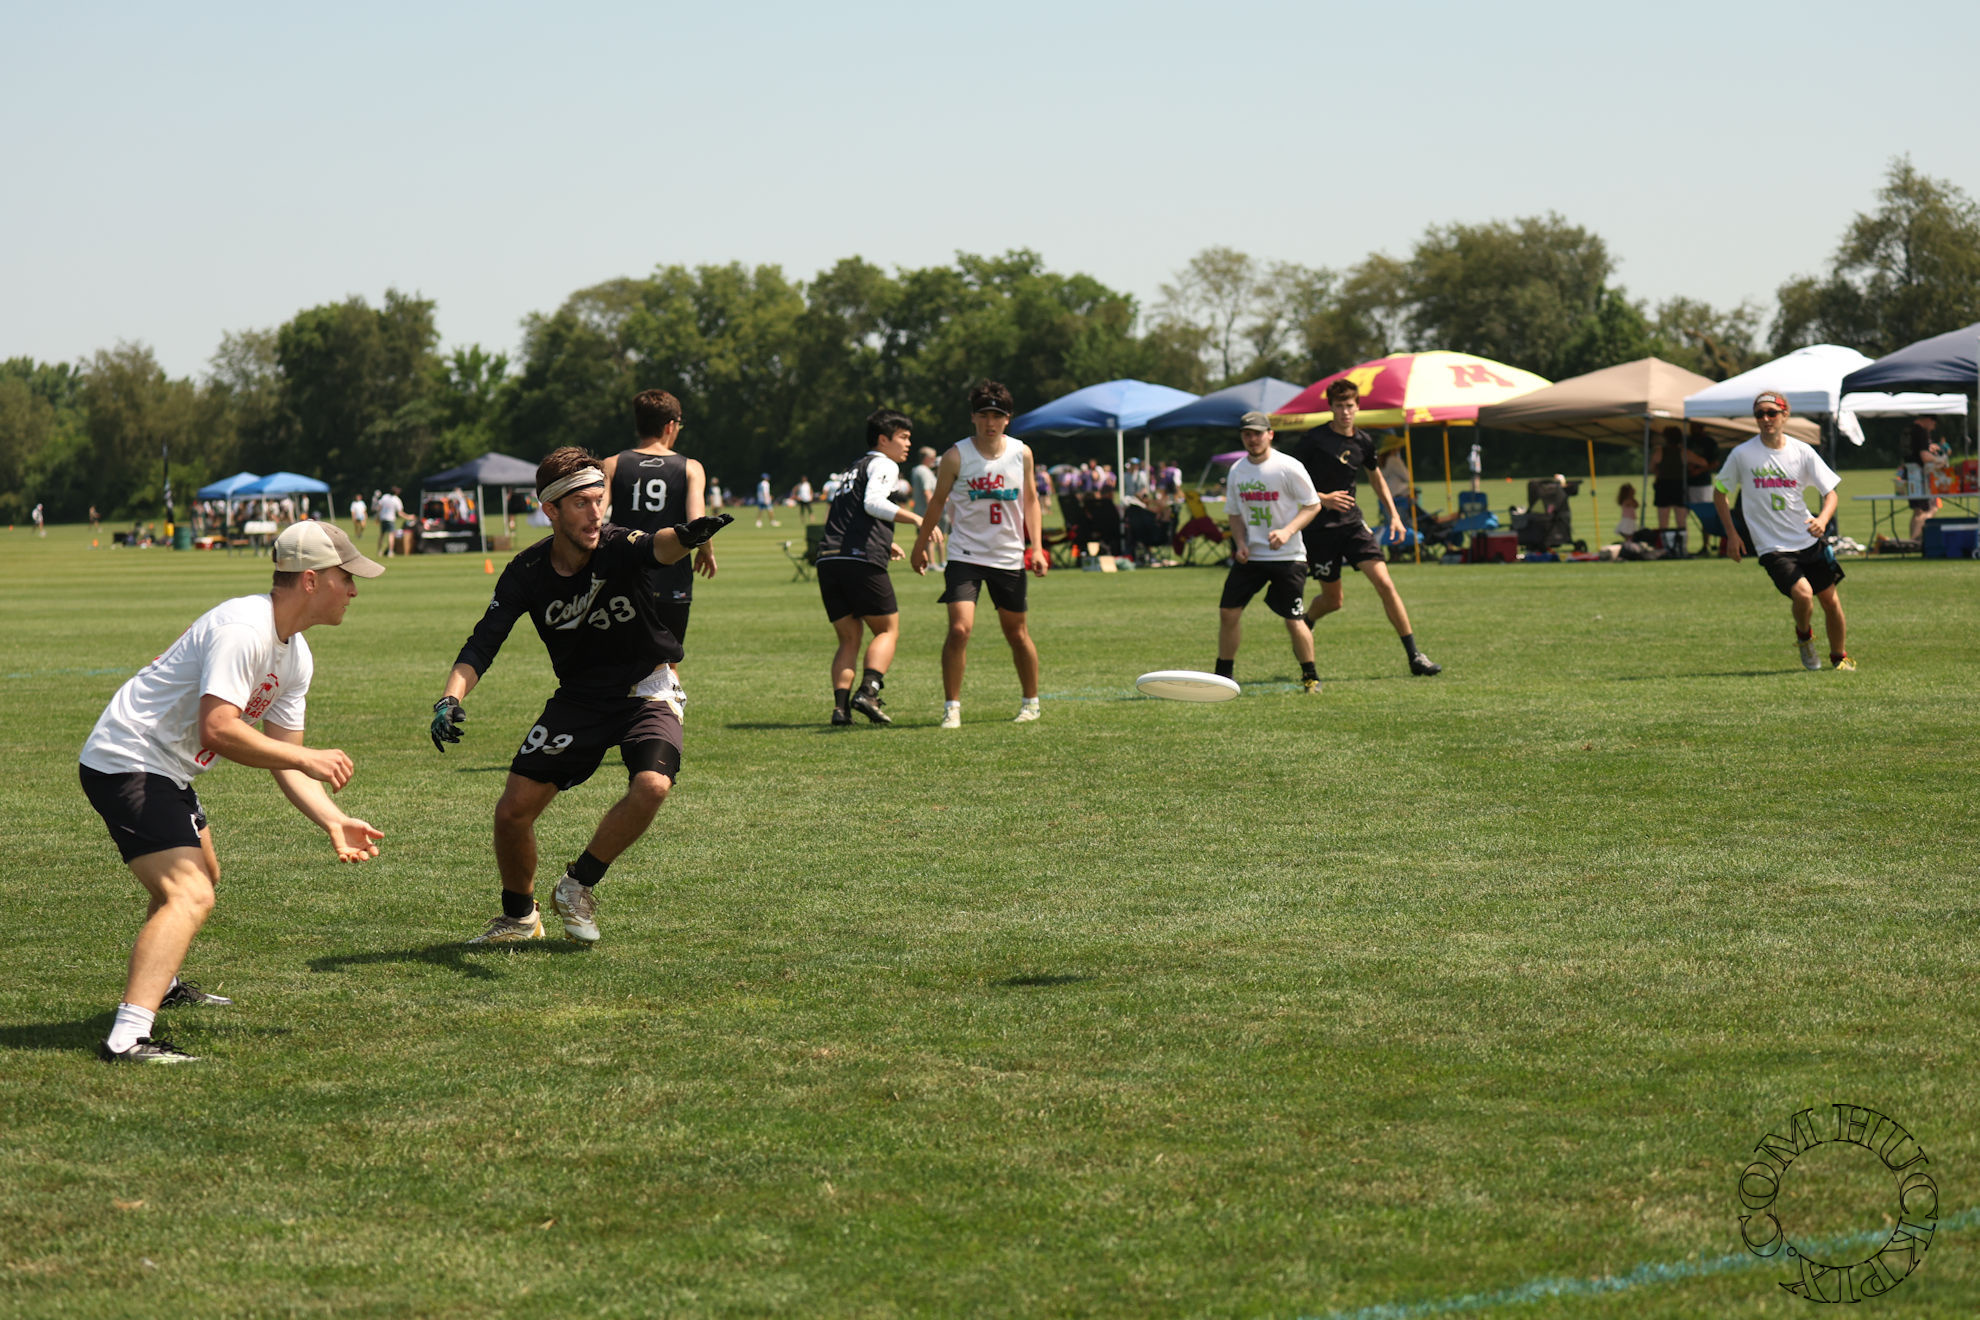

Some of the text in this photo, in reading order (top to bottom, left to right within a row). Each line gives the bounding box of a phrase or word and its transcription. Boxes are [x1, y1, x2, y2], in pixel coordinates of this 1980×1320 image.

[631, 478, 667, 512] 19
[990, 504, 1002, 524] 6
[1248, 506, 1272, 528] 34
[521, 725, 573, 755] 93
